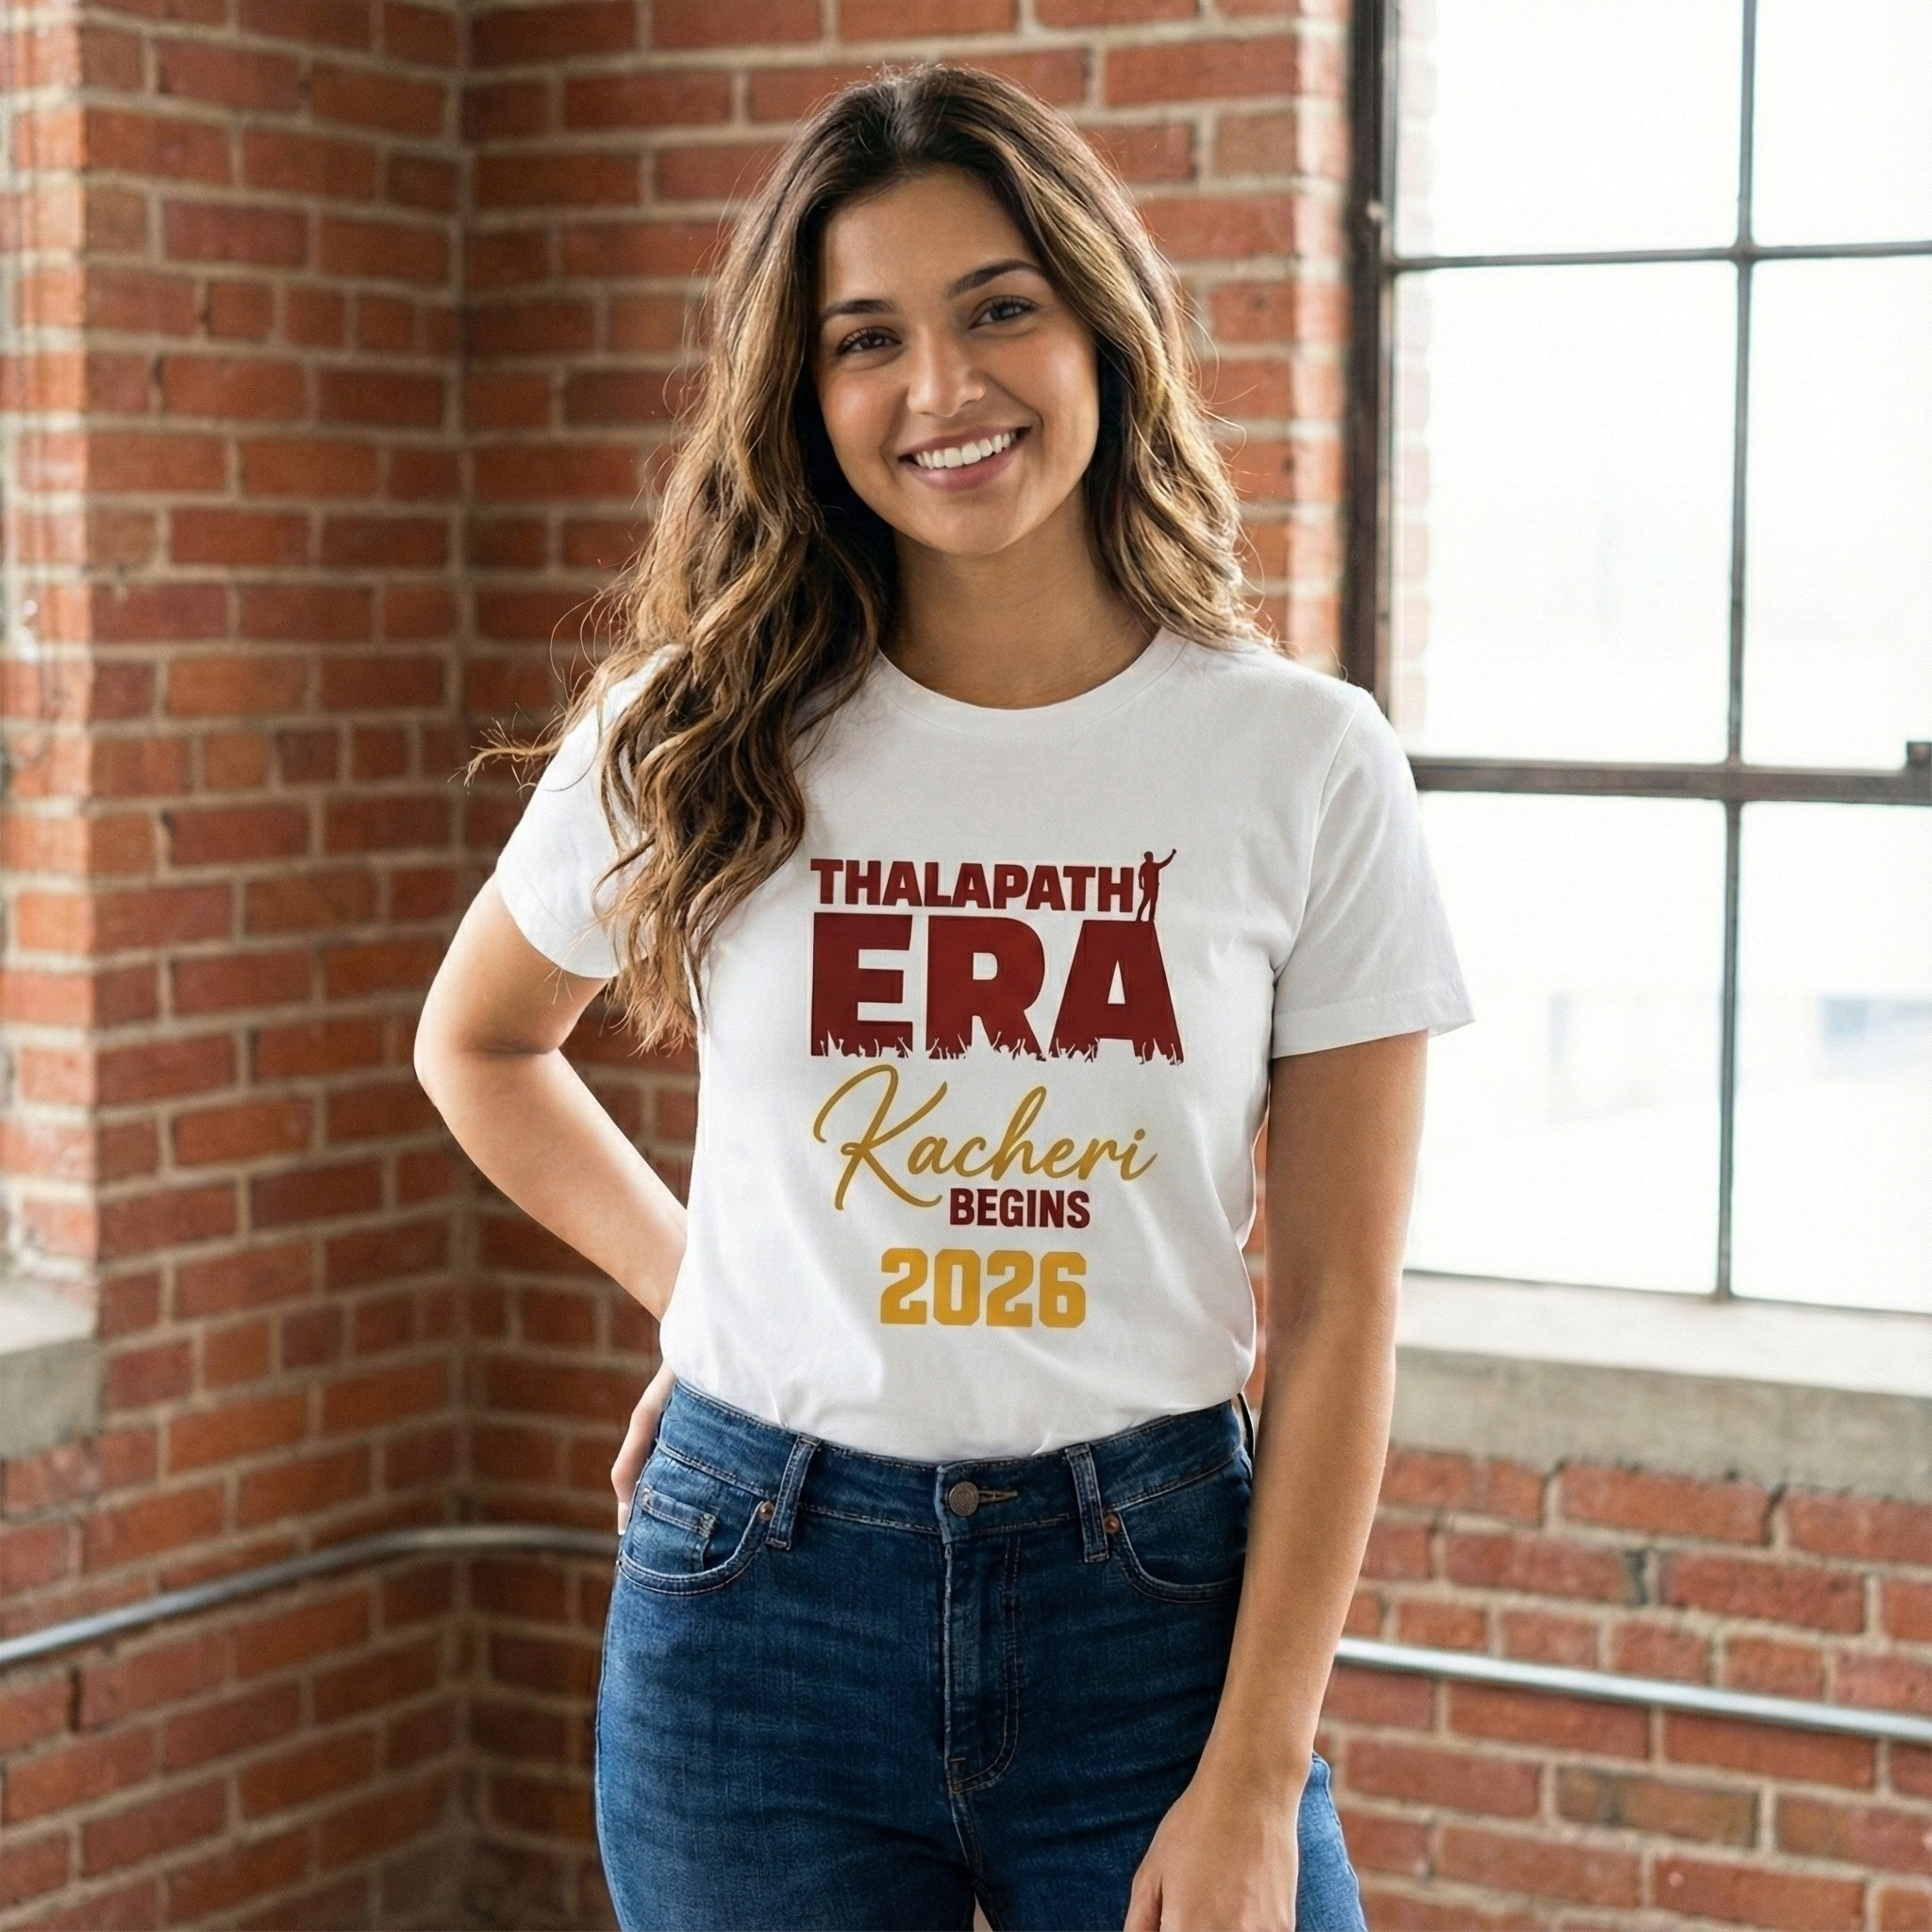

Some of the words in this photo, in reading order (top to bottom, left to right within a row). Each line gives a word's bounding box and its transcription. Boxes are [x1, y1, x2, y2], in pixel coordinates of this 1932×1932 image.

[810, 911, 1185, 1066] ERA
[812, 1064, 1158, 1210] Kacheri
[949, 1188, 1091, 1229] BEGINS
[879, 1247, 1088, 1328] 2026
